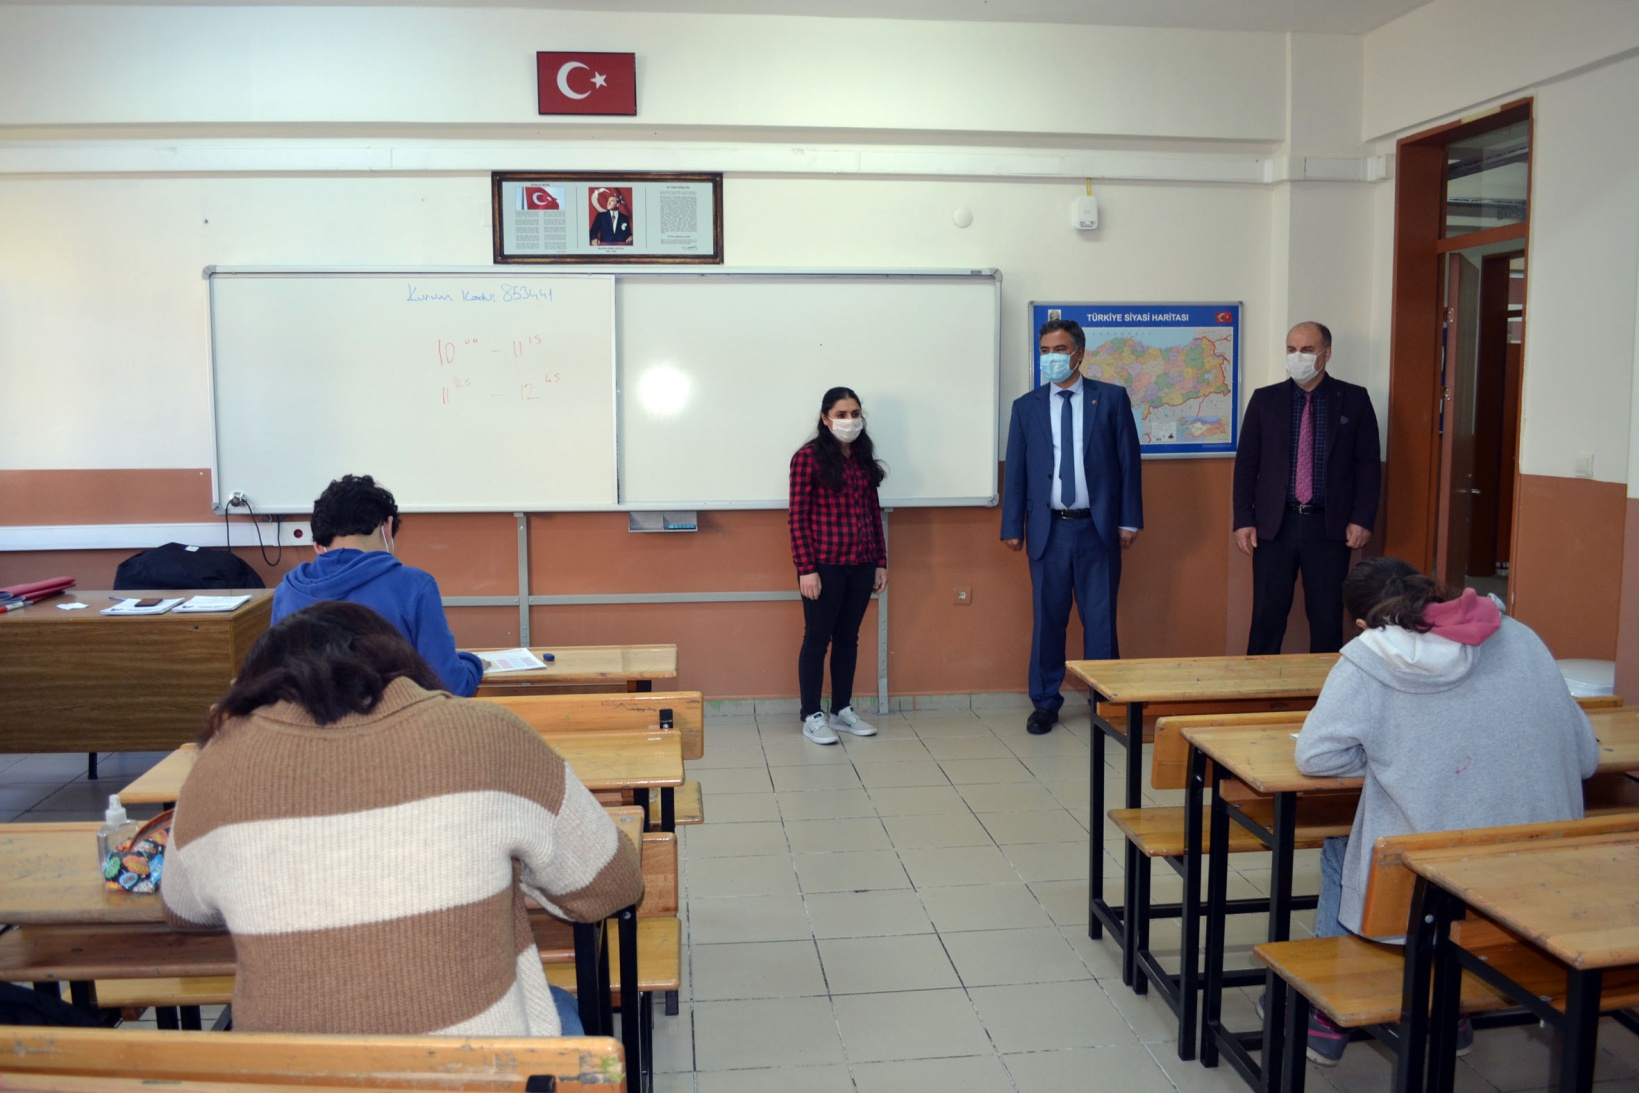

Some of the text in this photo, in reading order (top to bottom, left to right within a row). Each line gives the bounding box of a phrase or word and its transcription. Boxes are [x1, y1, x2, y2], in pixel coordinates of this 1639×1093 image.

[501, 283, 553, 303] 853441
[1087, 312, 1189, 322] TÜRKİYE SİYASİ HARİTASI
